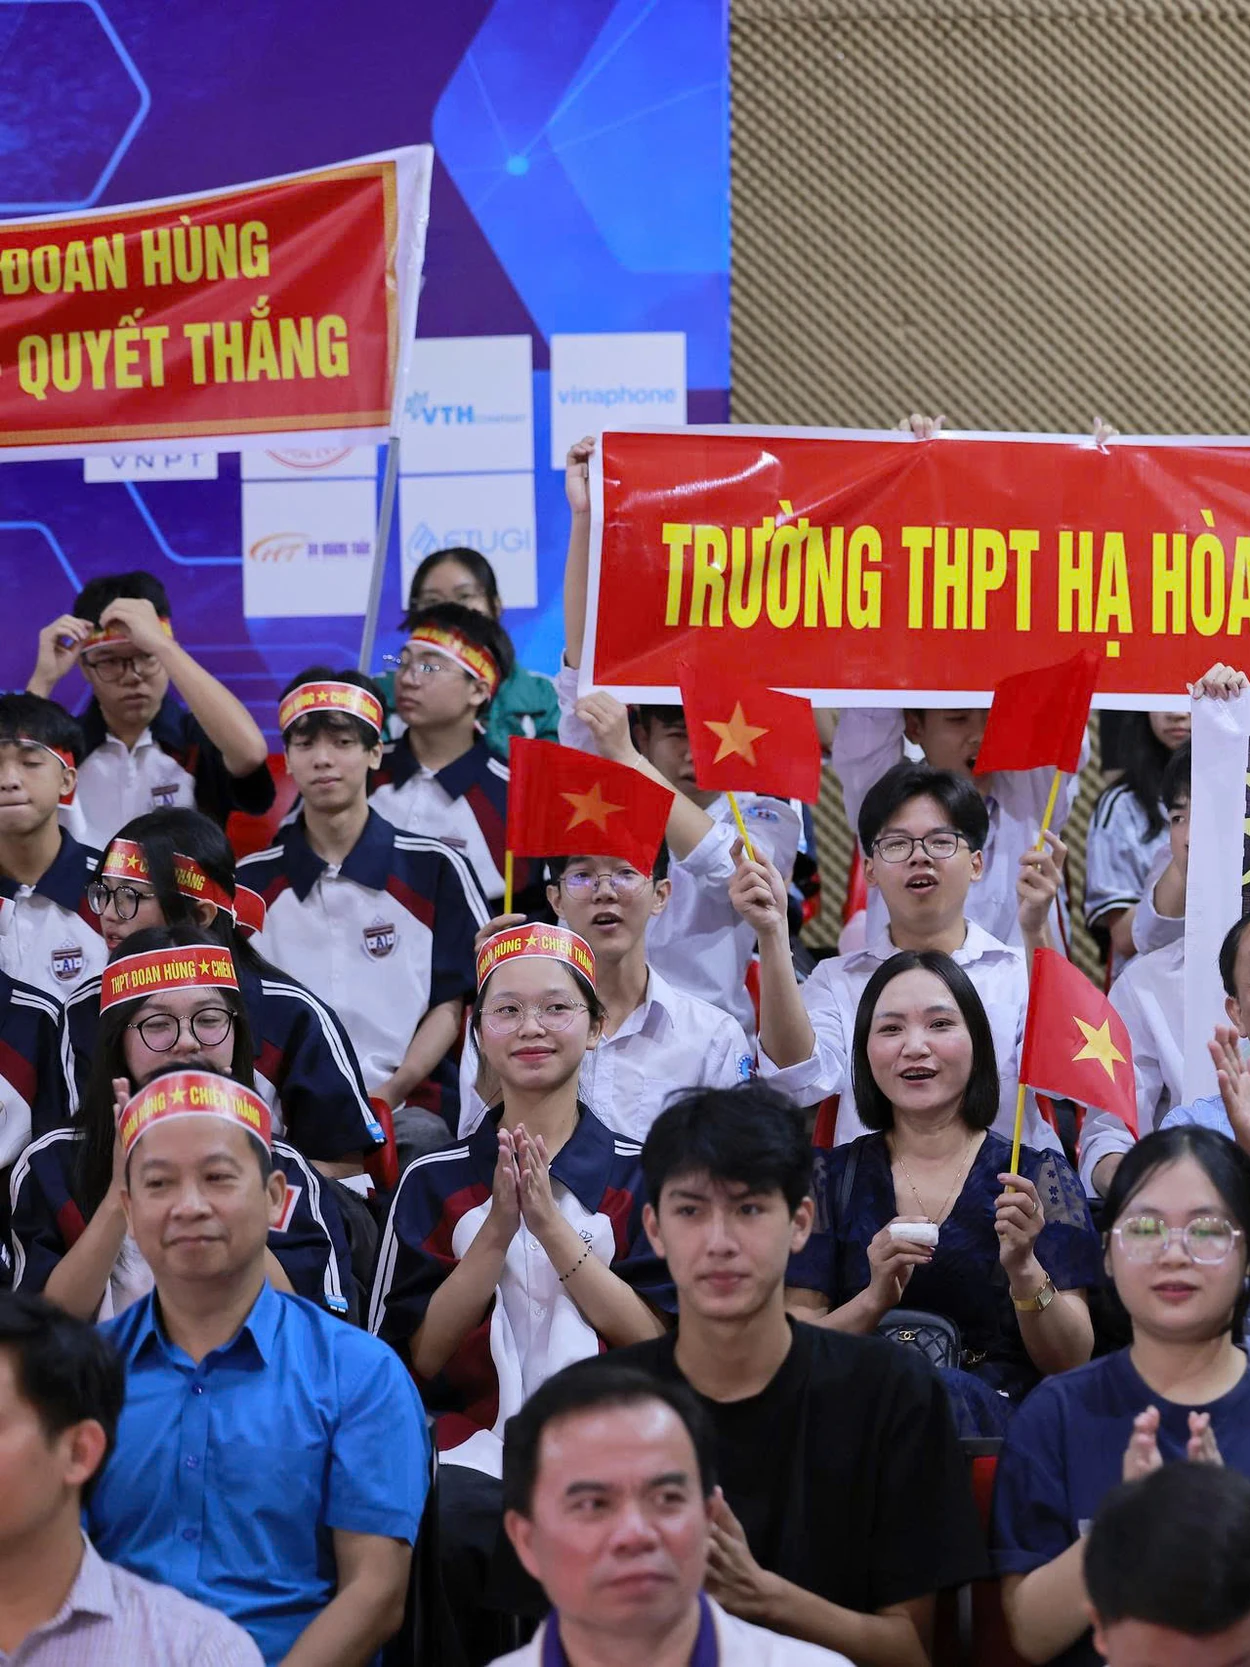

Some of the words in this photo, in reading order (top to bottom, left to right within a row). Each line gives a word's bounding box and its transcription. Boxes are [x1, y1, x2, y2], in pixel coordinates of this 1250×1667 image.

[0, 233, 128, 295] ĐOAN
[141, 214, 270, 287] HÙNG
[18, 307, 170, 400] QUYẾT
[183, 295, 349, 385] THẮNG
[422, 405, 474, 425] VTH
[557, 385, 677, 408] vinaphone
[661, 500, 883, 629] TRƯỜNG
[902, 526, 1040, 631] THPT
[1058, 530, 1134, 658] HẠ
[494, 938, 522, 959] HÙNG
[110, 972, 130, 995] THPT
[131, 965, 161, 987] ĐOAN
[163, 958, 196, 980] HÙNG
